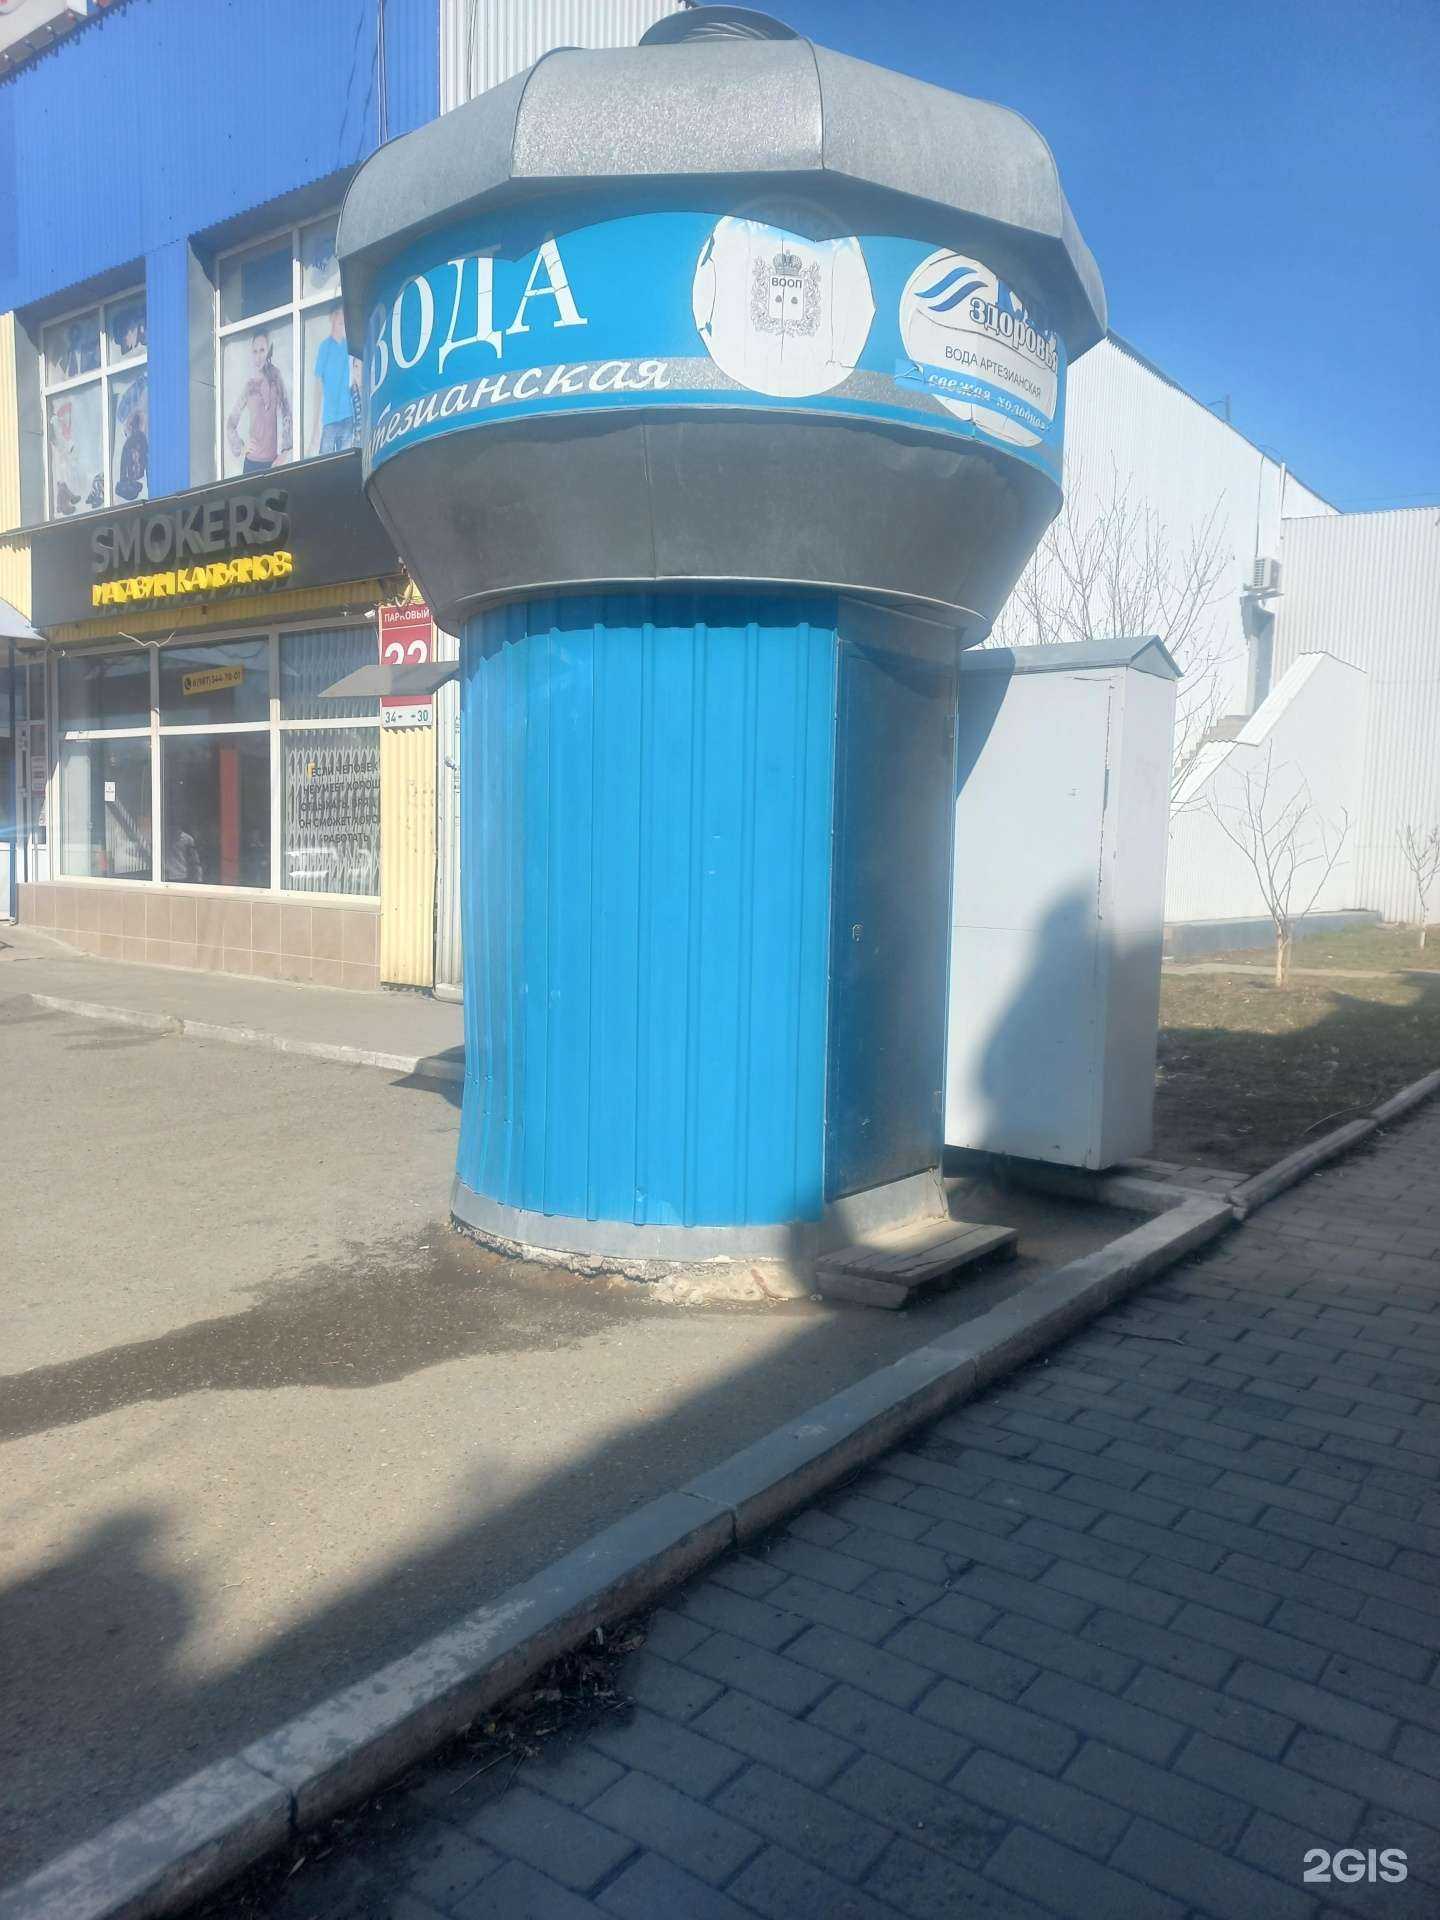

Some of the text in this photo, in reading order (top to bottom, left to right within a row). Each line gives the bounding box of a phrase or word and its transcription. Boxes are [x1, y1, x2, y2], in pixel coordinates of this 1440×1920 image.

[771, 277, 803, 289] ВООП
[945, 345, 1042, 399] ВОДА АРТЕЗИАНСКАЯ
[92, 488, 290, 574] SMOKERS
[177, 550, 293, 594] КАЛЬЯНОВ
[312, 761, 378, 778] ЕСЛИ ЧЕЛОВЕК
